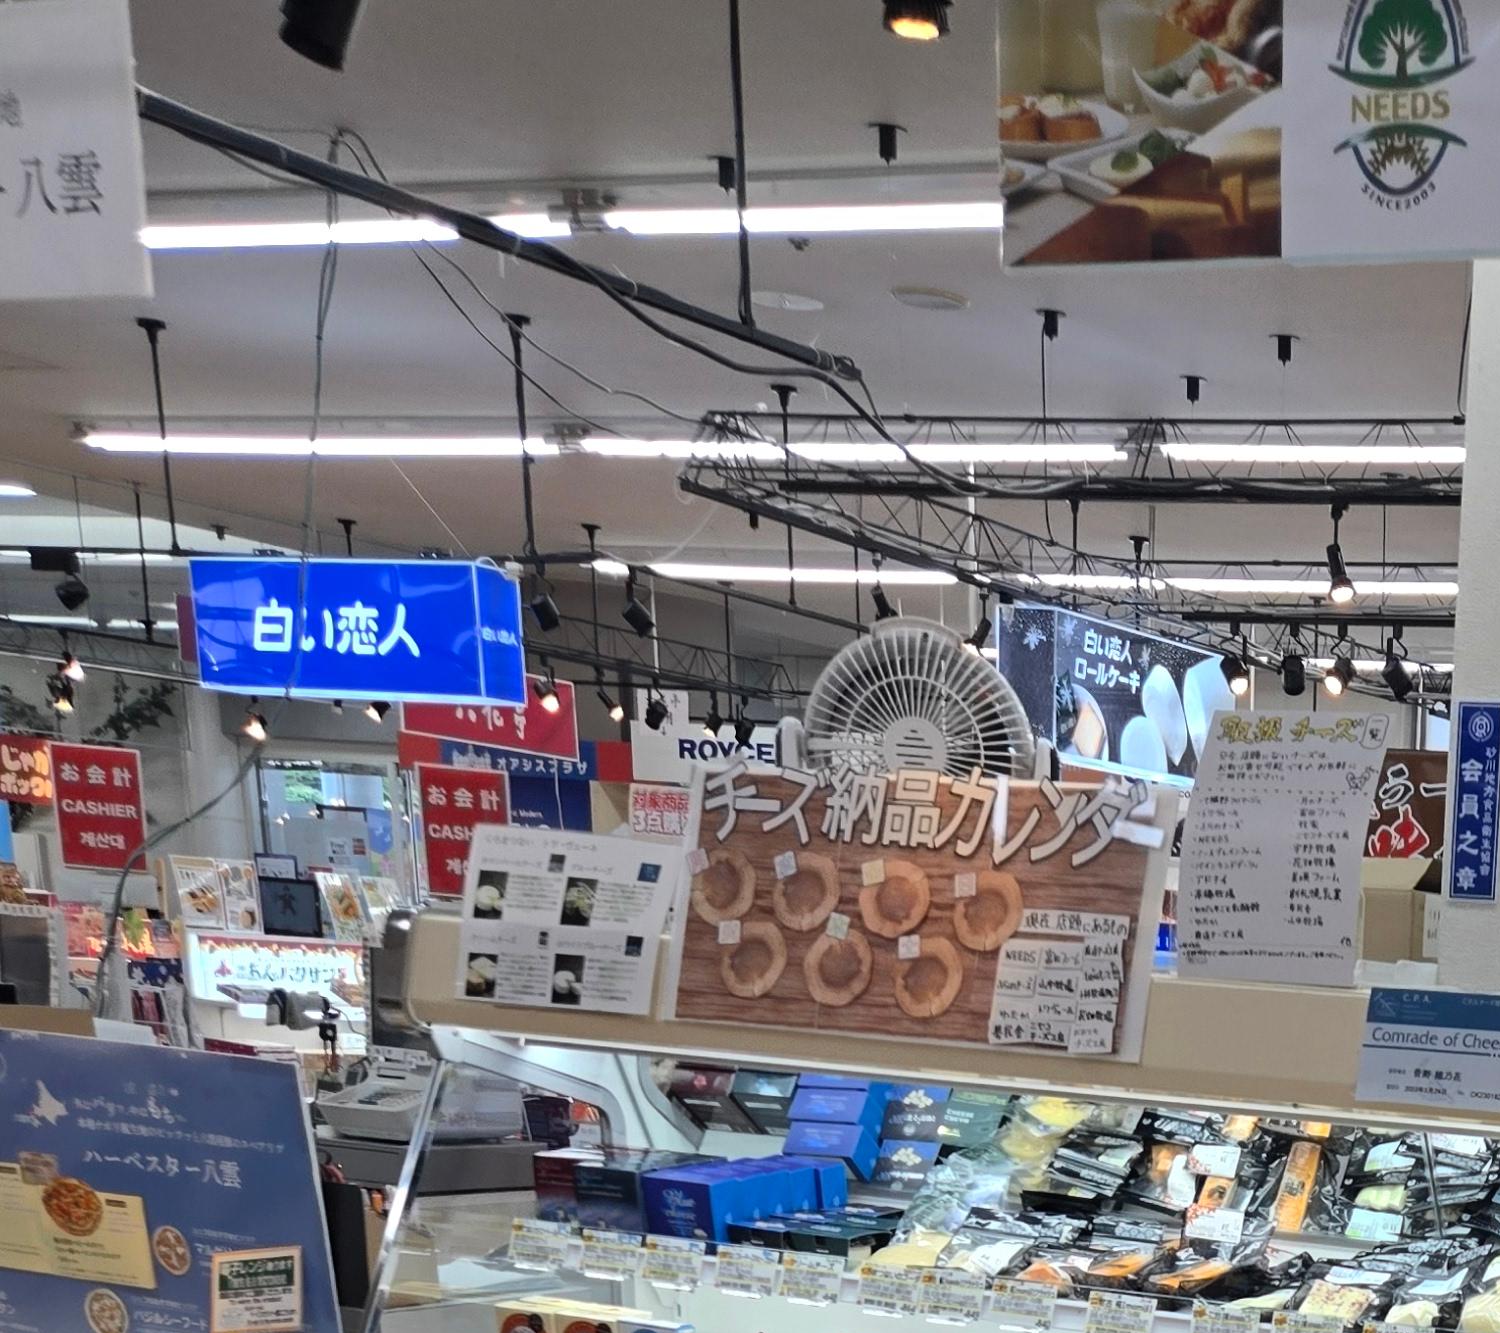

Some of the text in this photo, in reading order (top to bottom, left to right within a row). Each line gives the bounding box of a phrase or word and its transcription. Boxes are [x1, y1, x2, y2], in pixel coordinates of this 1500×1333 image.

[1351, 91, 1450, 123] NEEDS
[0, 149, 104, 219] 八雲
[253, 596, 421, 657] 白い恋人
[1083, 628, 1133, 665] 白い恋人
[1073, 656, 1141, 695] ロールケーキ
[60, 762, 132, 788] お会計
[61, 798, 139, 819] CASHIER
[427, 785, 501, 811] お会計
[704, 764, 1165, 869] チーズ納品カレンダー
[428, 823, 474, 841] CASH
[1456, 757, 1484, 891] 会員之章
[1372, 1027, 1439, 1046] Comrade
[1443, 1030, 1460, 1048] of
[82, 1149, 242, 1189] ハーベスター八雲
